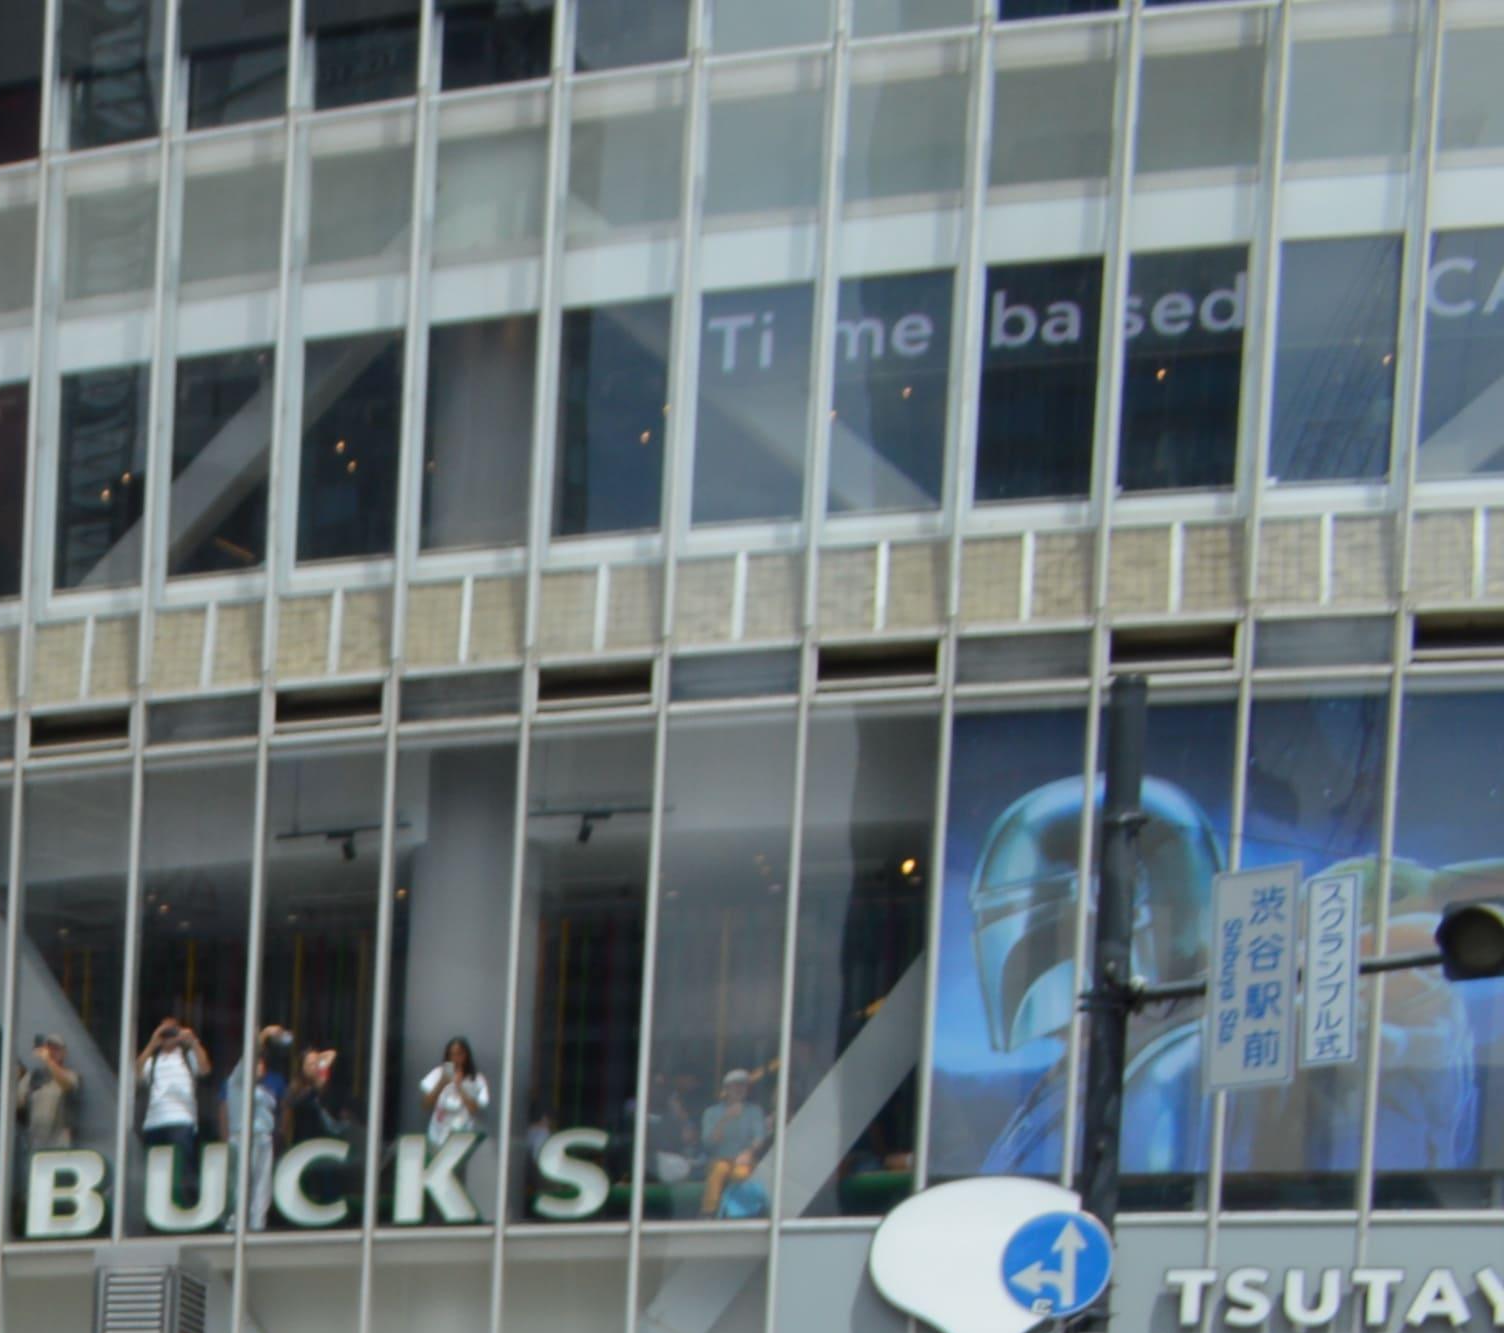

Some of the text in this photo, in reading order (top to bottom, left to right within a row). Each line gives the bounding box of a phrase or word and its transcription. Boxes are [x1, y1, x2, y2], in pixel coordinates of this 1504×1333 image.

[707, 309, 935, 373] Time
[989, 272, 1248, 349] based
[1220, 918, 1243, 1001] Shibuya
[1243, 885, 1286, 1069] 渋谷駅前
[1314, 882, 1346, 1057] スクランブル式
